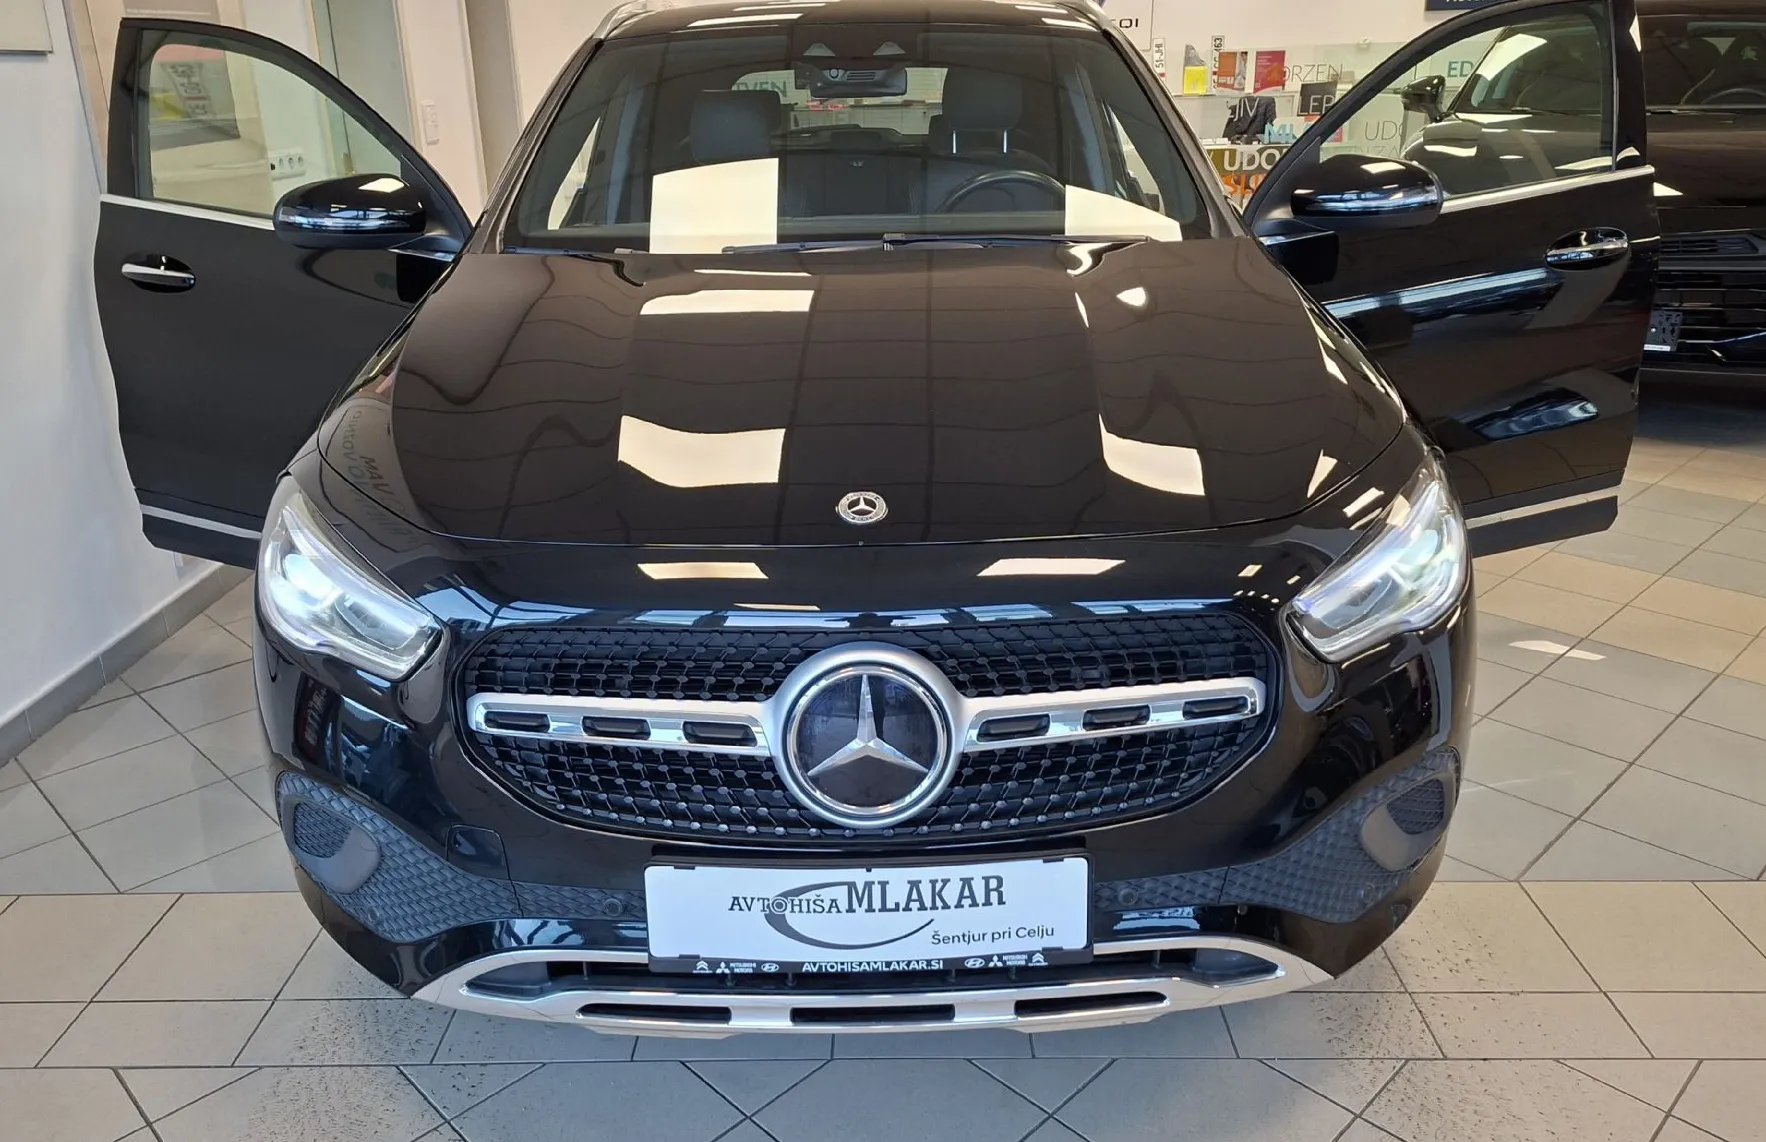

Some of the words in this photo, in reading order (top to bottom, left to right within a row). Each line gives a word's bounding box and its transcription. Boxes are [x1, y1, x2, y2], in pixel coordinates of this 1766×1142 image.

[1365, 120, 1402, 141] UD
[1224, 149, 1287, 171] UDO
[728, 894, 842, 914] AVTOHIŠA
[846, 875, 1006, 913] MLAKAR
[931, 929, 988, 946] Šentjur
[991, 927, 1012, 943] pri
[1015, 925, 1055, 940] Celju
[802, 960, 944, 973] AVTOHISAMLAKAR.SI
